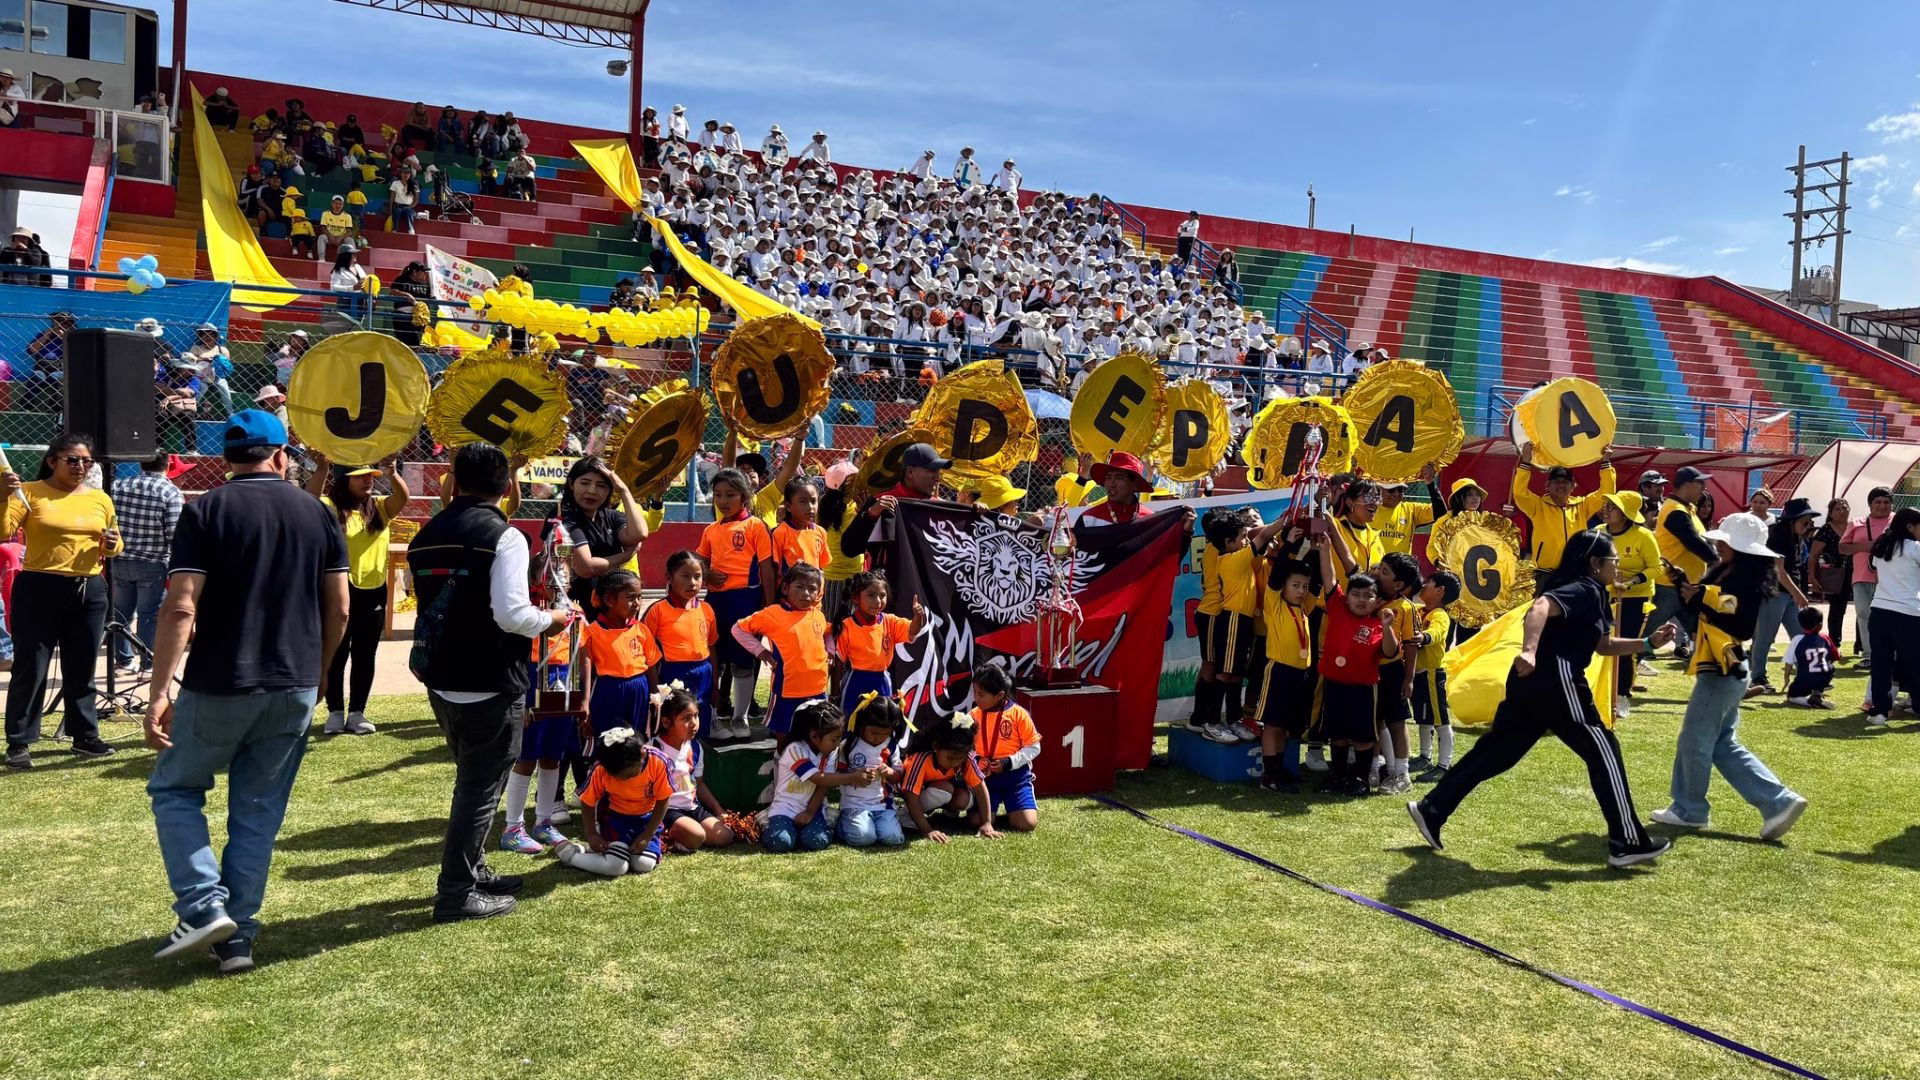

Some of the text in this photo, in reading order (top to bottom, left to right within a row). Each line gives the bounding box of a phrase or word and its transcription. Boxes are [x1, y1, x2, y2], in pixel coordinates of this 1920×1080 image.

[768, 144, 782, 157] T
[961, 163, 972, 185] L
[324, 362, 387, 440] J
[461, 377, 544, 445] E
[736, 353, 800, 425] U
[1093, 375, 1147, 443] E
[952, 399, 1009, 461] D
[1172, 410, 1209, 467] P
[1363, 395, 1415, 453] A
[1559, 390, 1601, 449] A
[533, 465, 570, 479] VAMOS
[635, 419, 681, 488] S
[1463, 544, 1502, 601] G
[1062, 725, 1085, 768] 1
